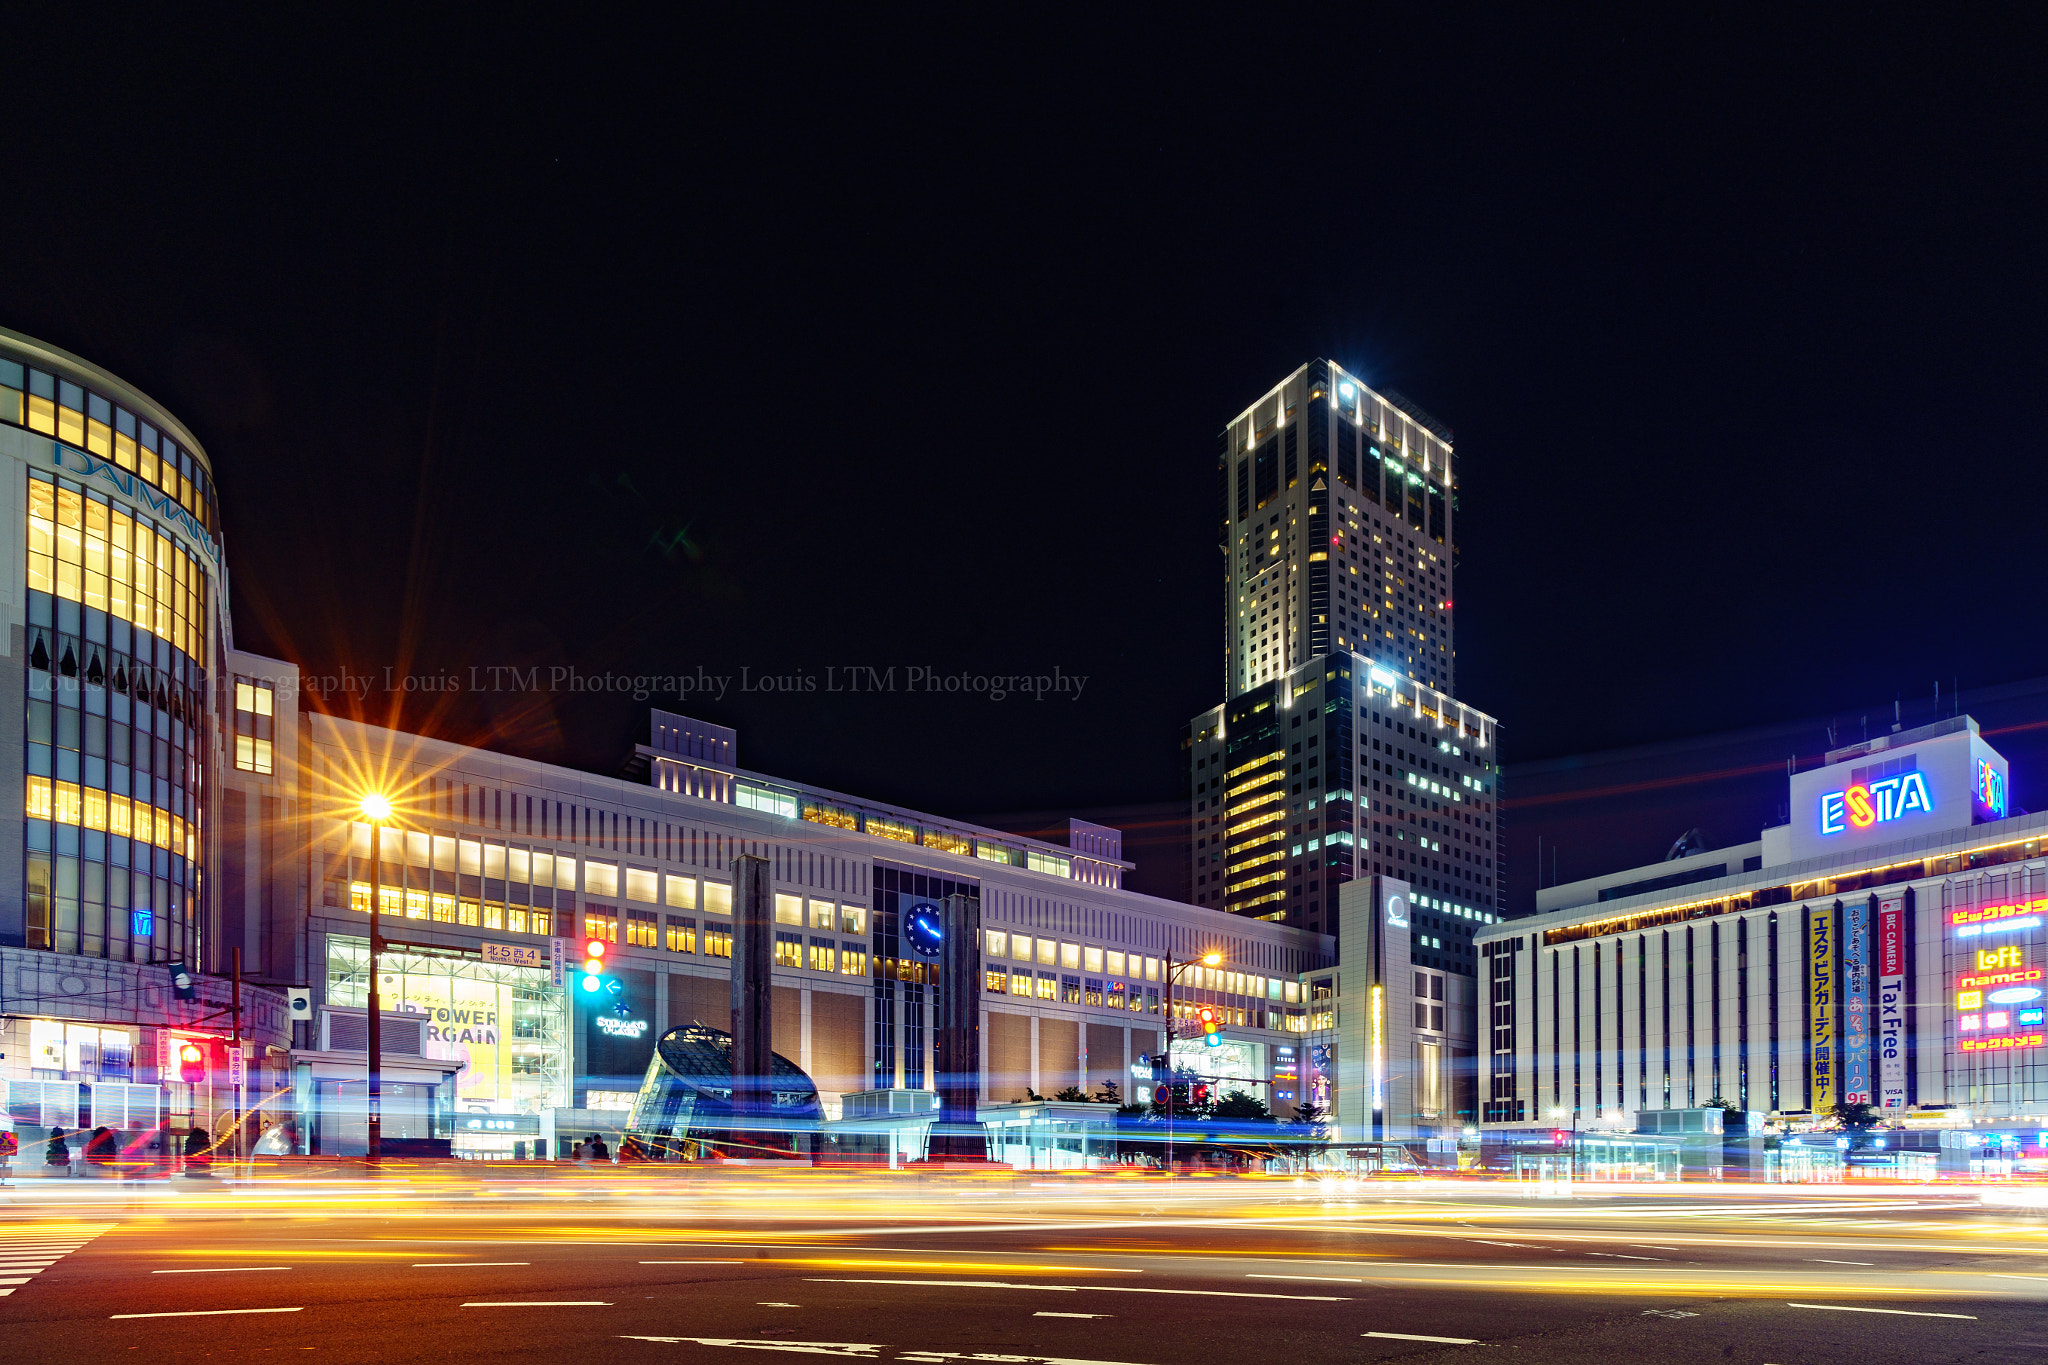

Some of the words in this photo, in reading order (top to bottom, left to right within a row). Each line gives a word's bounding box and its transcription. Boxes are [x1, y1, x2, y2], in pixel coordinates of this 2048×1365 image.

[54, 442, 220, 564] DAIMARU
[1821, 771, 1932, 835] ESTA
[1976, 758, 2005, 817] ESTA
[1886, 913, 1896, 930] BIC
[1952, 899, 2048, 924] ビックカメラ
[488, 945, 535, 960] 北5西4
[1886, 932, 1896, 974] CAMERA
[1961, 970, 2041, 988] namco
[1882, 980, 1902, 1015] Tax
[1883, 1018, 1902, 1059] Free
[1962, 1035, 2043, 1050] ビックカメラ
